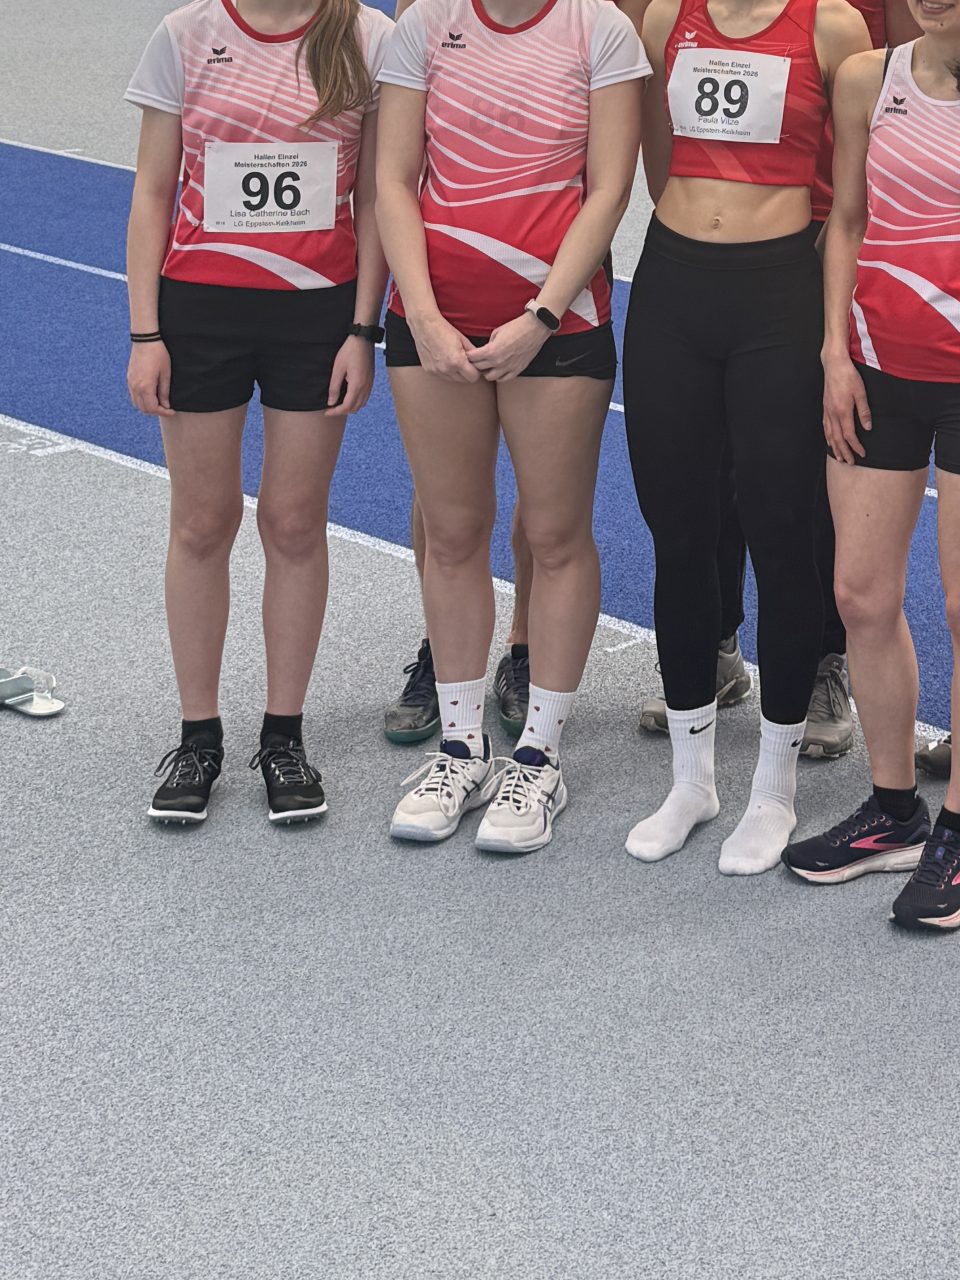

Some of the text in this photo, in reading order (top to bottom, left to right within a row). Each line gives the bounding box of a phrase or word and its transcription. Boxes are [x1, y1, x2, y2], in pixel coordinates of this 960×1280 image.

[207, 56, 233, 64] erima
[694, 77, 748, 118] 89
[242, 171, 301, 210] 96
